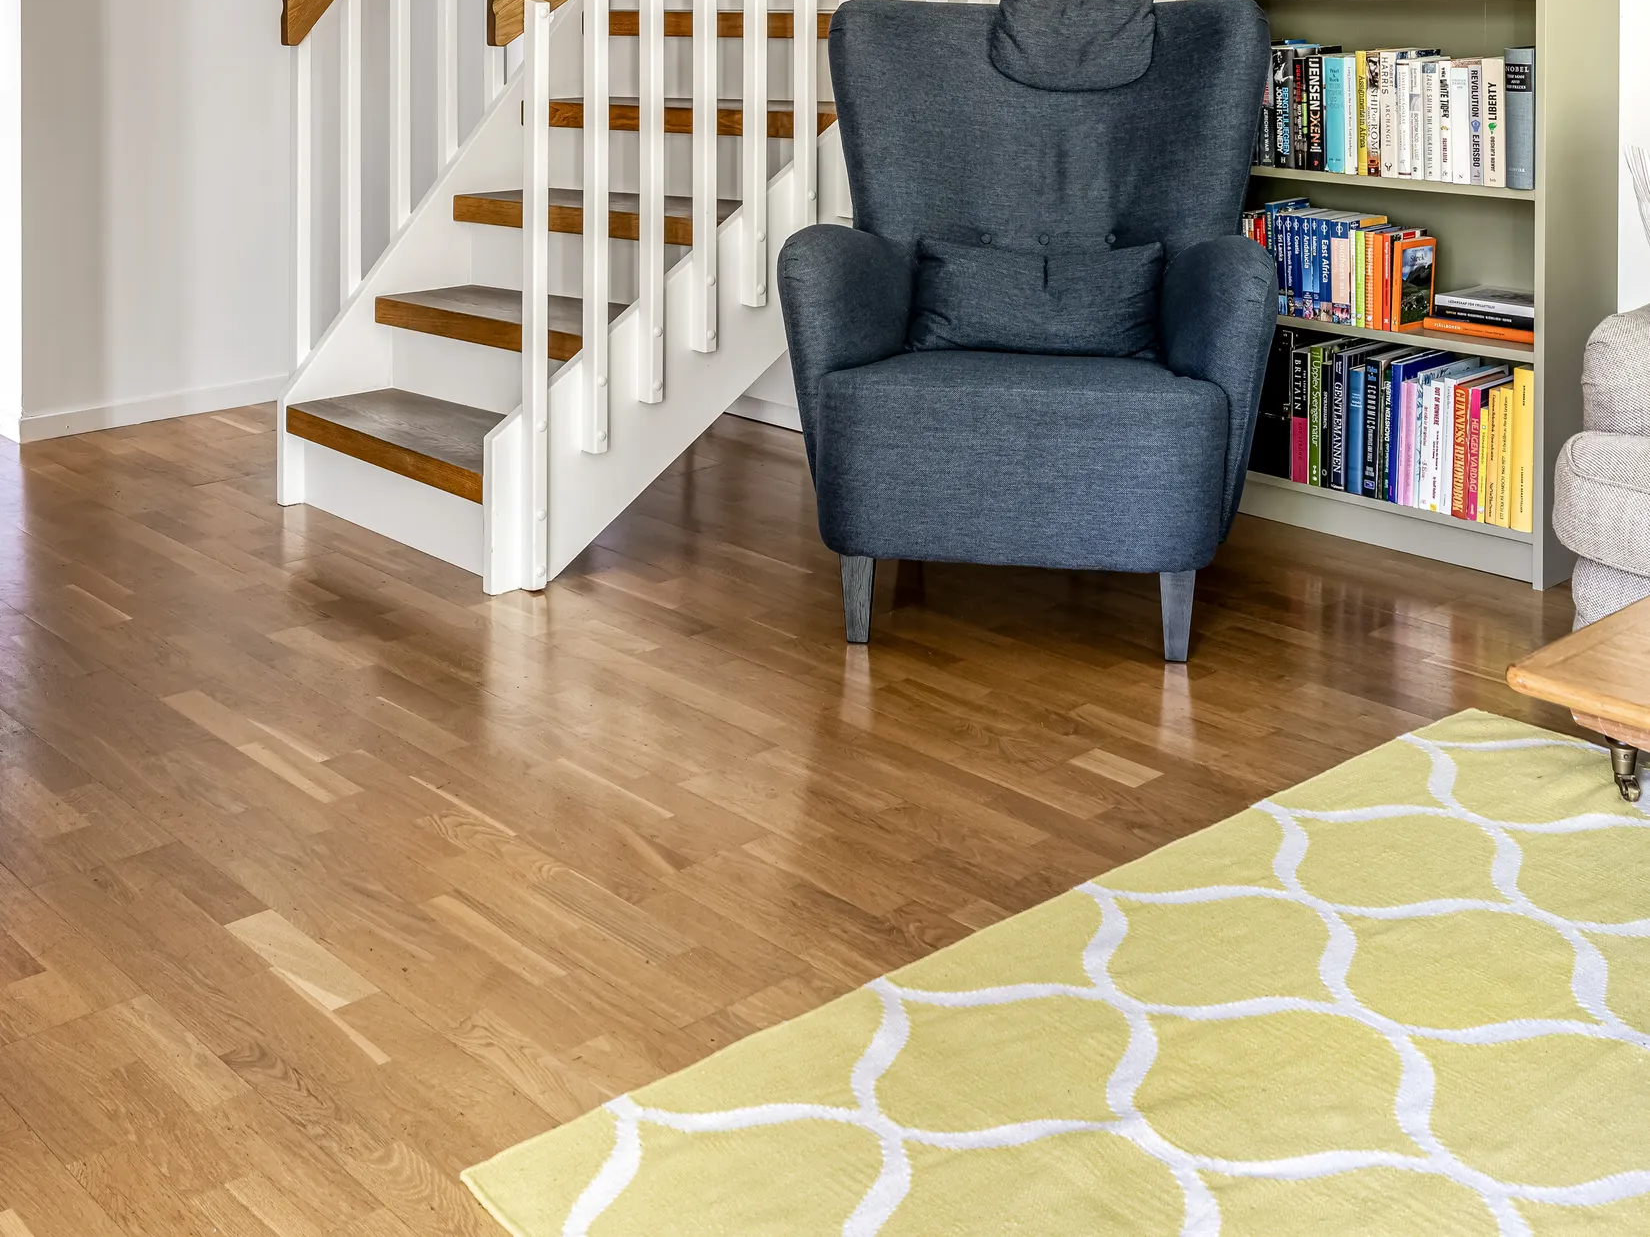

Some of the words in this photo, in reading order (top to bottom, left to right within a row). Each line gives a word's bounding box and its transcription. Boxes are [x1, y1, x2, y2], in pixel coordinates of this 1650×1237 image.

[1308, 64, 1320, 110] JENSEN
[1381, 57, 1389, 95] HARRIS
[1440, 79, 1449, 98] WHITE
[1358, 76, 1366, 119] Assignments
[1370, 89, 1379, 113] SHIP
[1440, 99, 1449, 119] TIGER
[1470, 70, 1480, 118] REVOLUTION
[1488, 82, 1498, 121] LIBERTY
[1282, 114, 1290, 155] LILJEGREN
[1359, 127, 1367, 149] Africa
[1370, 122, 1379, 156] ROME
[1472, 134, 1481, 167] EJERSBO
[1321, 239, 1329, 257] East
[1338, 241, 1346, 281] southeast
[1321, 258, 1330, 283] Africa
[1339, 281, 1347, 297] asia
[1294, 359, 1302, 410] BRITAIN
[1311, 360, 1322, 389] Upplev
[1310, 391, 1322, 422] Sveriges
[1366, 384, 1378, 429] ECONOMICS
[1454, 389, 1466, 445] GUINNESS
[1312, 425, 1321, 447] natur
[1332, 381, 1343, 473] GENTLEMANNEN
[1471, 418, 1479, 433] HEJ
[1470, 434, 1478, 455] IGEN
[1452, 445, 1465, 513] REKORDBOK
[1469, 456, 1478, 494] VARDAG!
